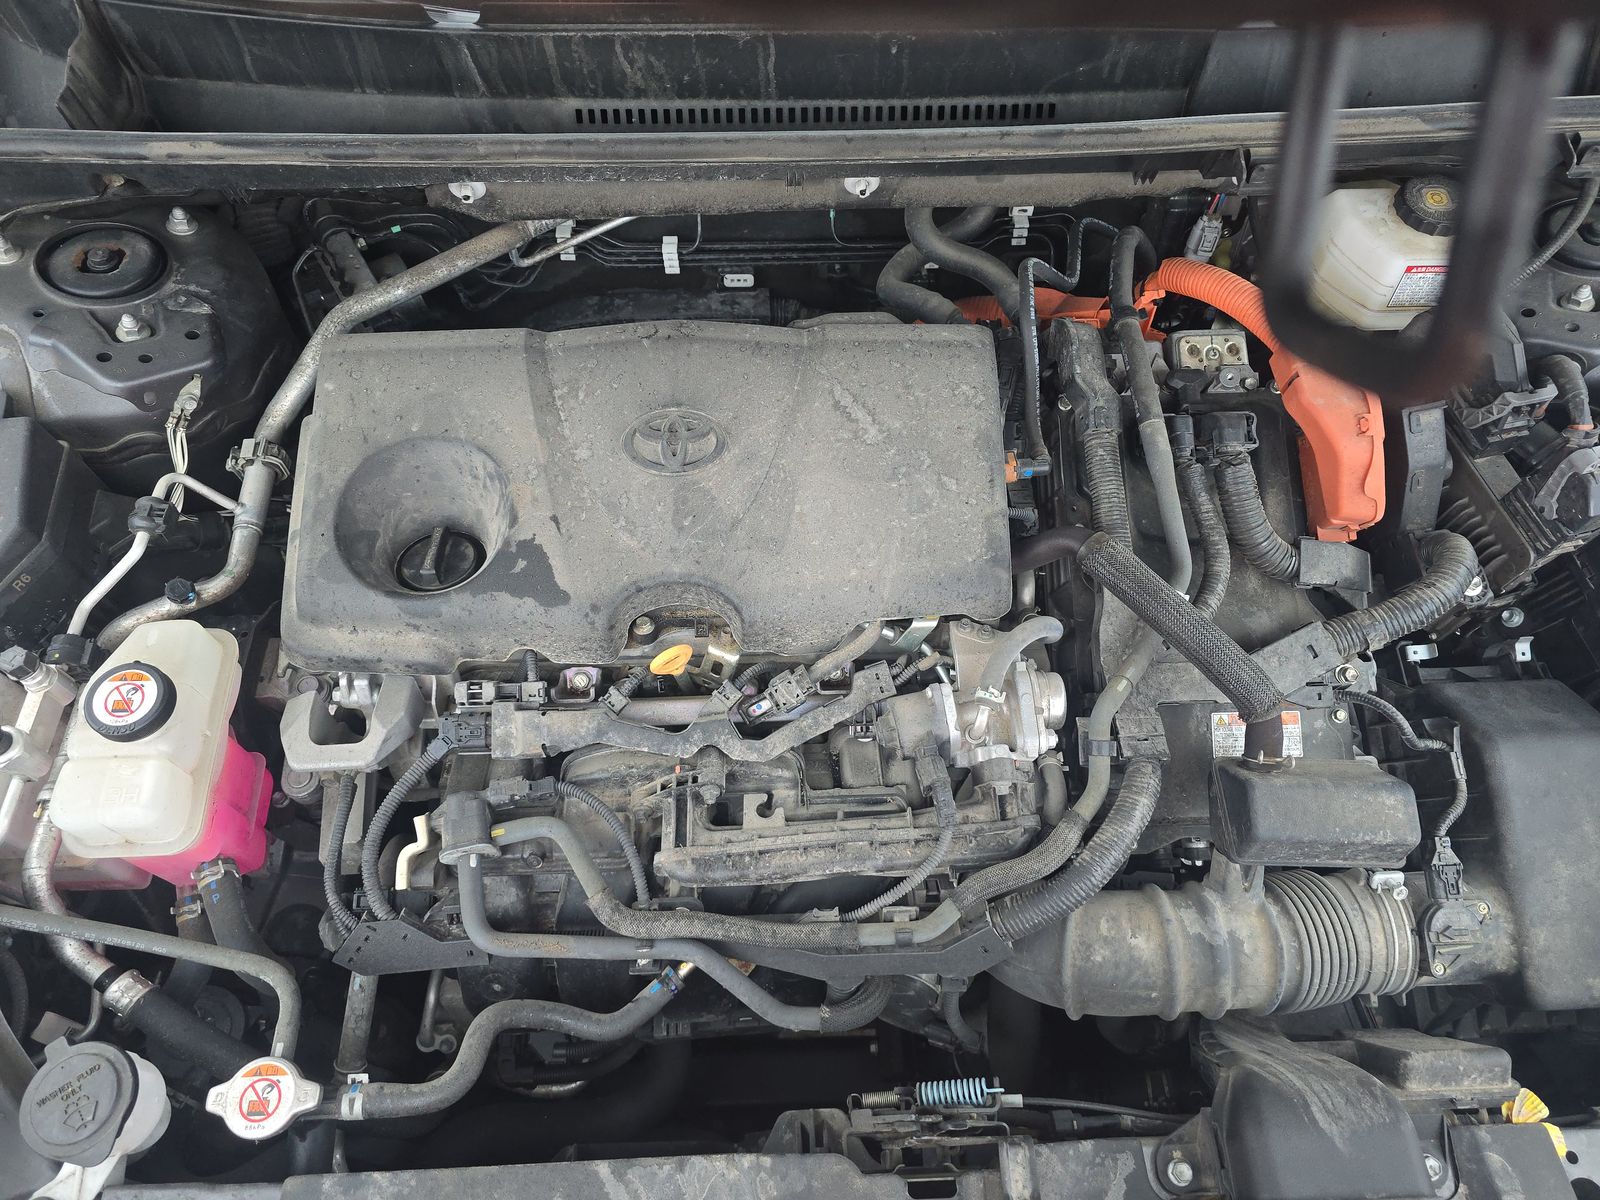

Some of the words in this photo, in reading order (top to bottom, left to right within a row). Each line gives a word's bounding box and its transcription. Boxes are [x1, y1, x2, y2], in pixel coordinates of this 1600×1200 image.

[12, 573, 32, 592] R6
[98, 722, 137, 735] DENSO
[36, 1081, 73, 1108] WASHER
[76, 1063, 101, 1083] FLUID
[60, 1083, 83, 1102] ONLY
